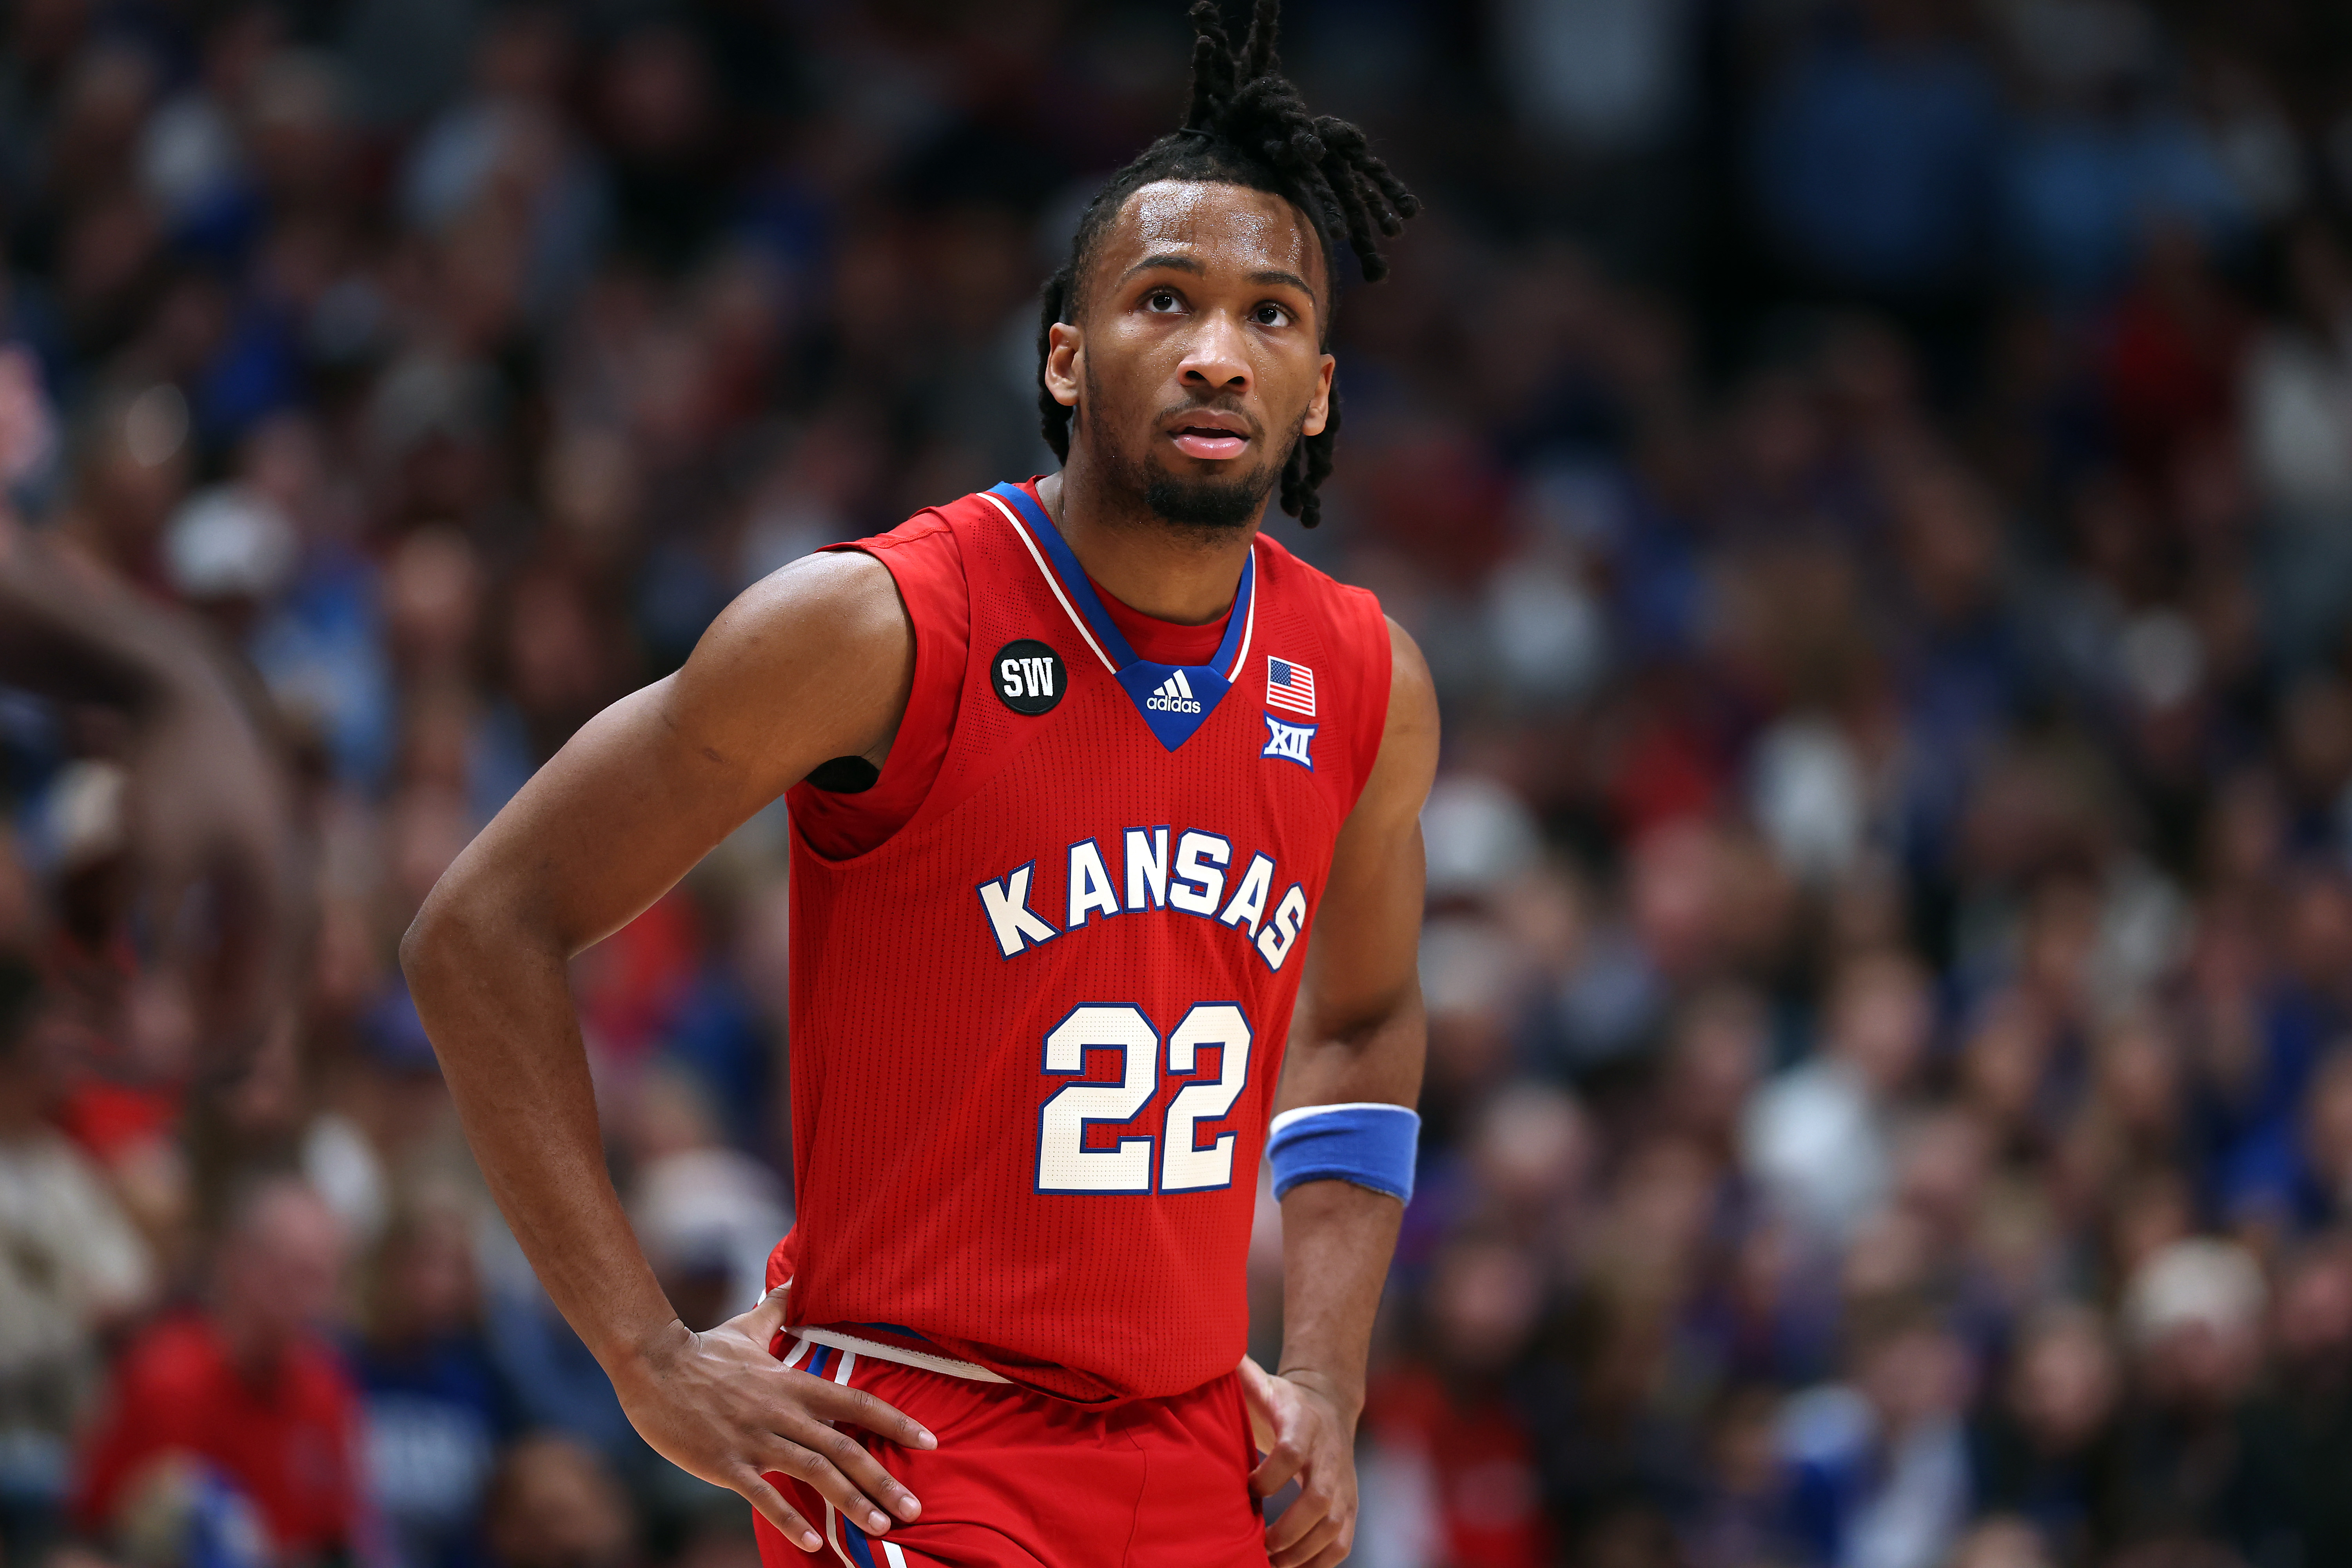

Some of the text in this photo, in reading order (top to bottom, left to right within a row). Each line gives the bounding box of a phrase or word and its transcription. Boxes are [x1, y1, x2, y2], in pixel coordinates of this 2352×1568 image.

[1001, 657, 1053, 697] SW
[1147, 695, 1201, 713] adidas
[1263, 716, 1315, 767] XII
[975, 824, 1308, 974] KANSAS
[1033, 1001, 1254, 1195] 22
